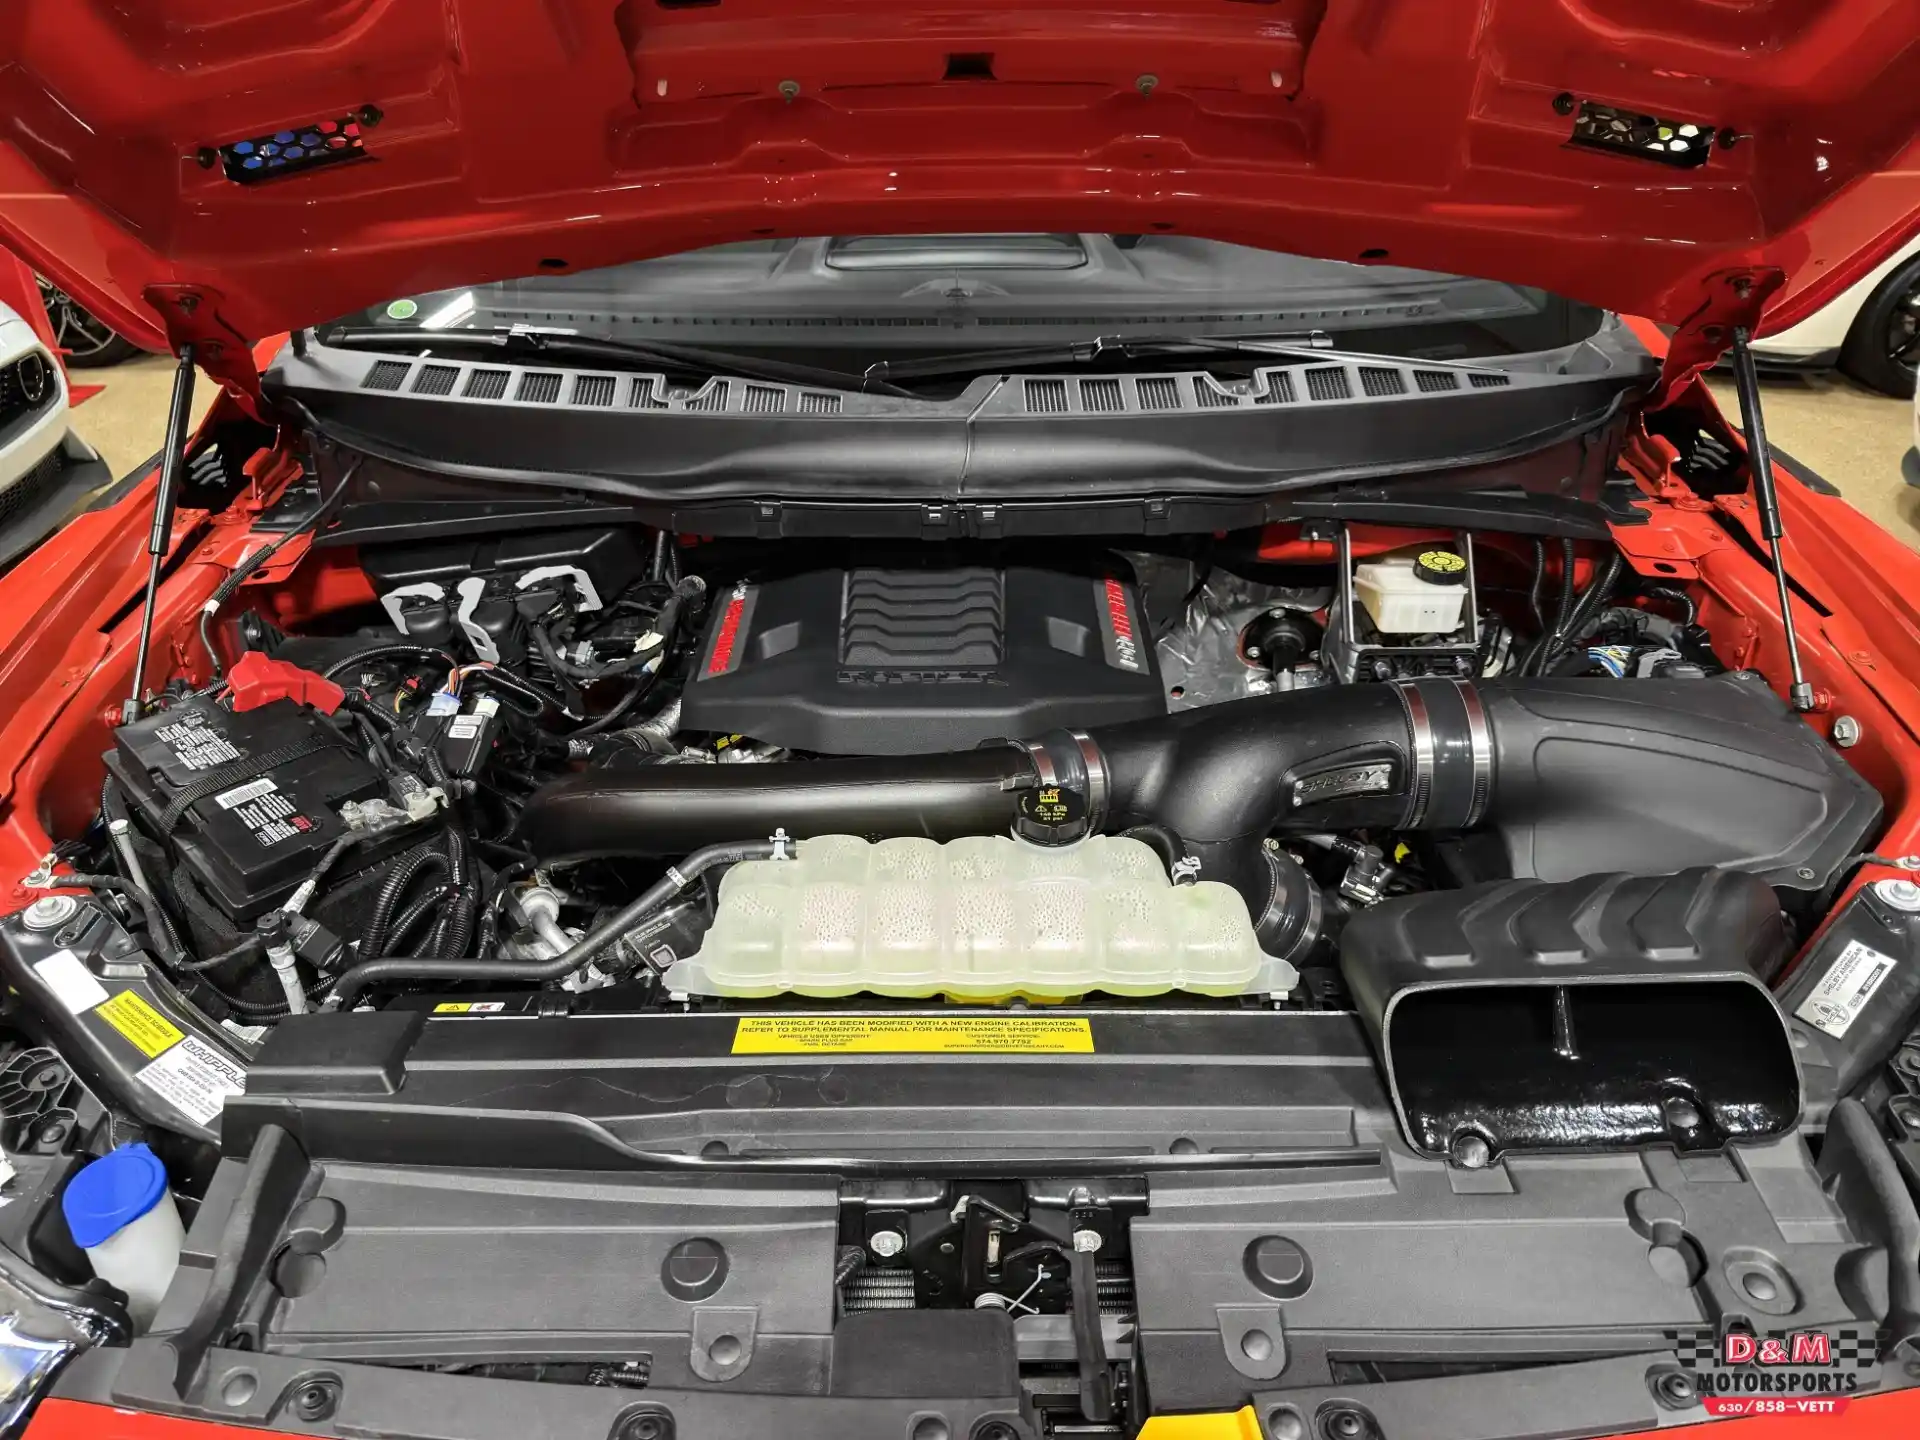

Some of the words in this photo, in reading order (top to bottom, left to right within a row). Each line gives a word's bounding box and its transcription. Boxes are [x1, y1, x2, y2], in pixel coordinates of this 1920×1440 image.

[1824, 974, 1841, 995] SHELBY
[1840, 947, 1862, 975] AMERICAN
[181, 1039, 246, 1089] WHIPPLE
